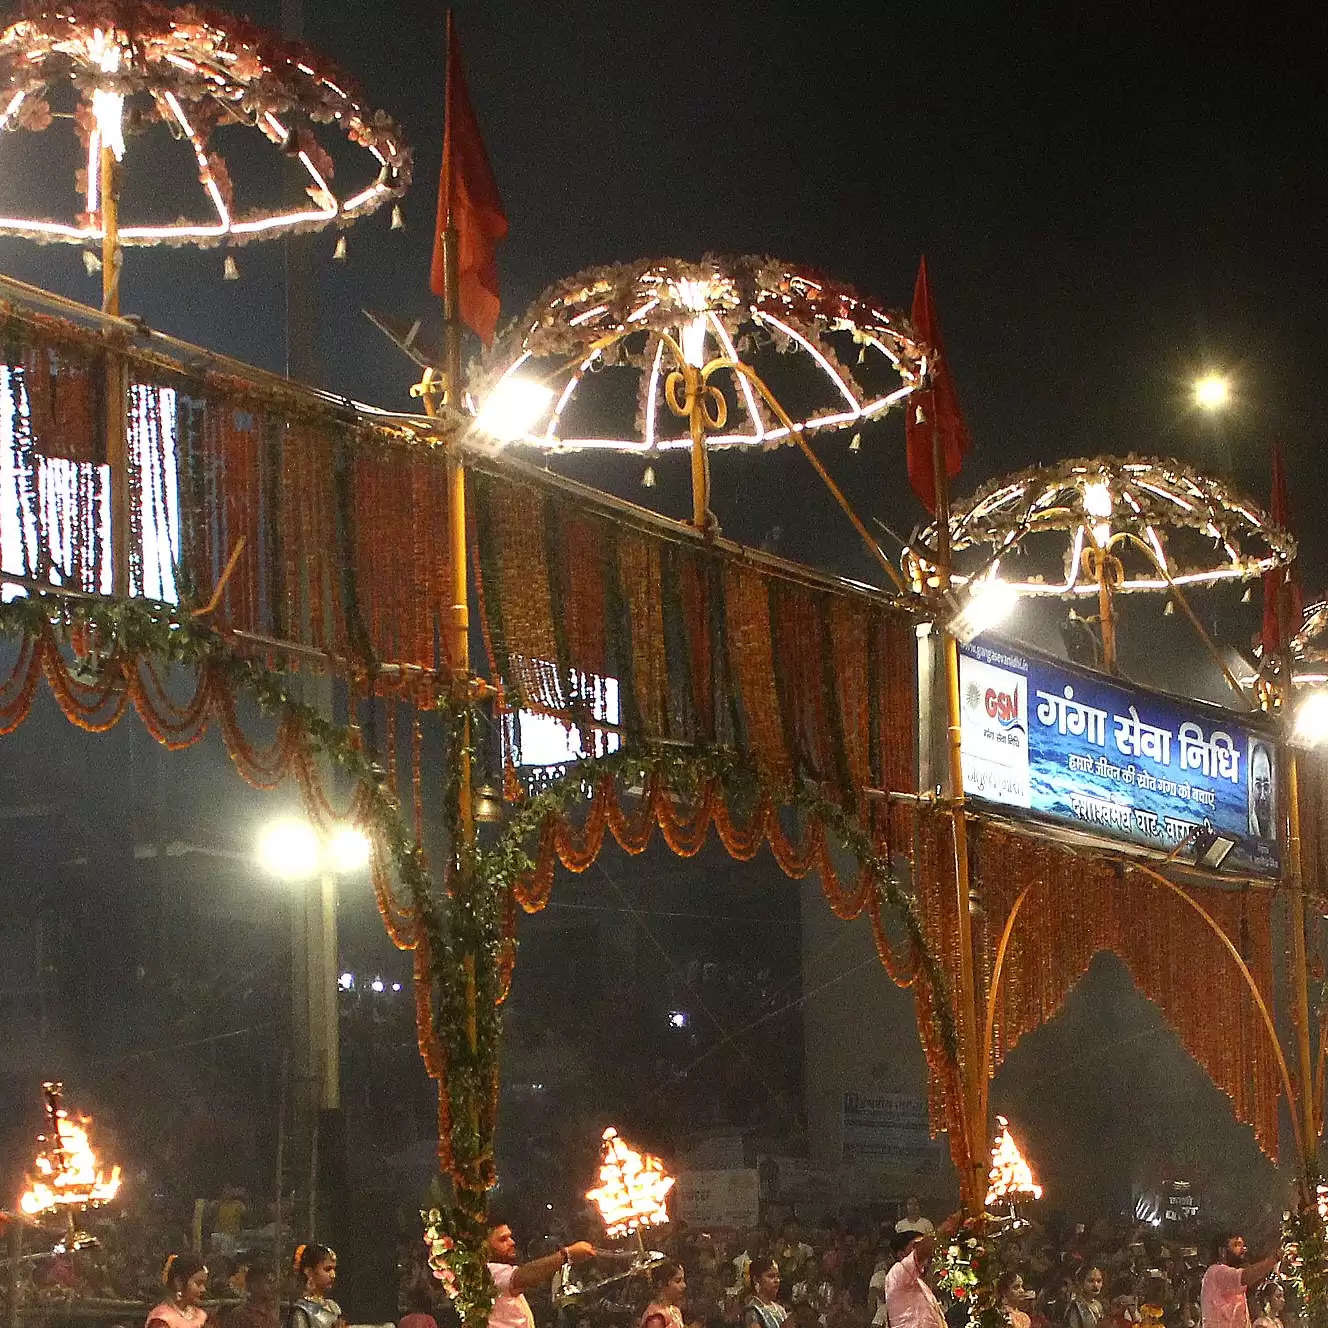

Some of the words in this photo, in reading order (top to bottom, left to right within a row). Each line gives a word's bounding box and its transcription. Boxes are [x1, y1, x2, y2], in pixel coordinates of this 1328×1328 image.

[1036, 685, 1108, 747] गंगा
[1113, 705, 1173, 766] सेवा
[1178, 721, 1242, 784] निधि
[1068, 753, 1094, 775] हमारे
[1095, 757, 1121, 782] जीवन
[1121, 764, 1136, 784] की
